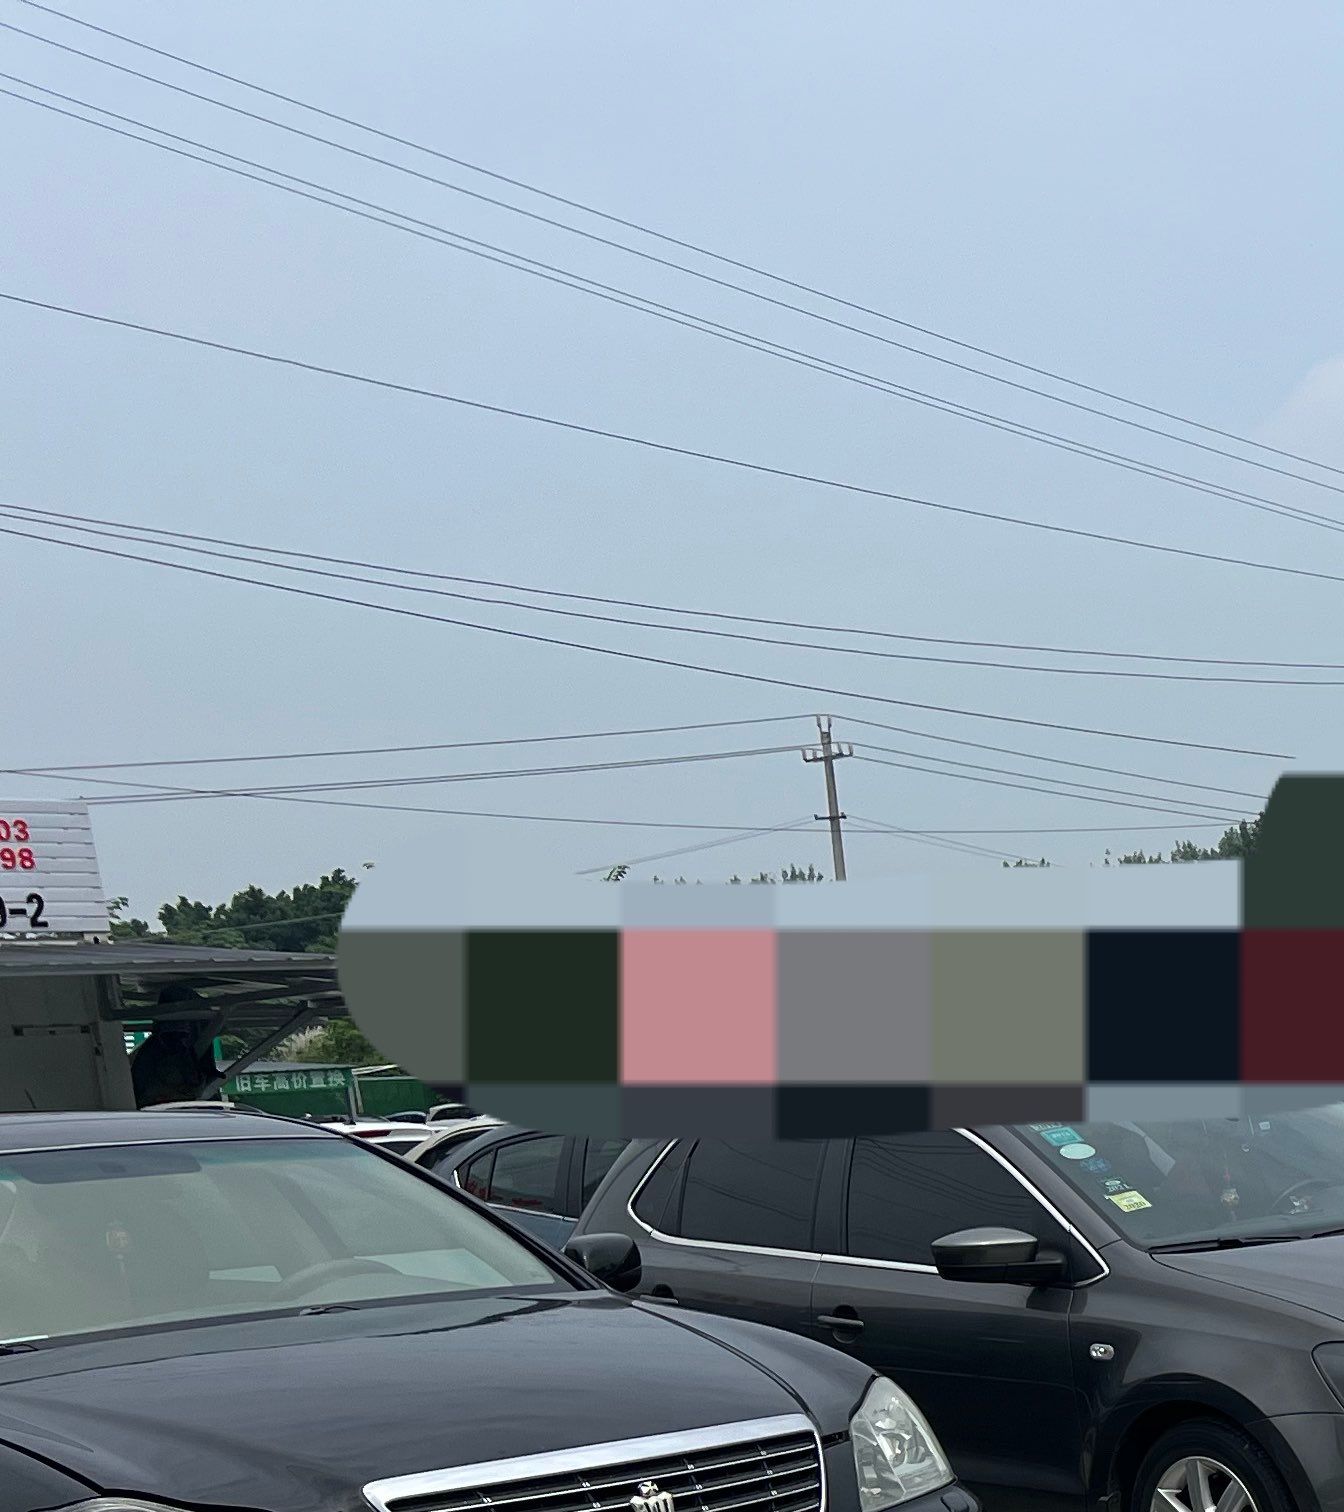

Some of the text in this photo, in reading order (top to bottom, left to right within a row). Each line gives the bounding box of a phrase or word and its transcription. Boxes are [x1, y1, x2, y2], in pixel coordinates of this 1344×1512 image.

[0, 847, 36, 870] 98
[236, 1069, 346, 1092] 旧车高价置换
